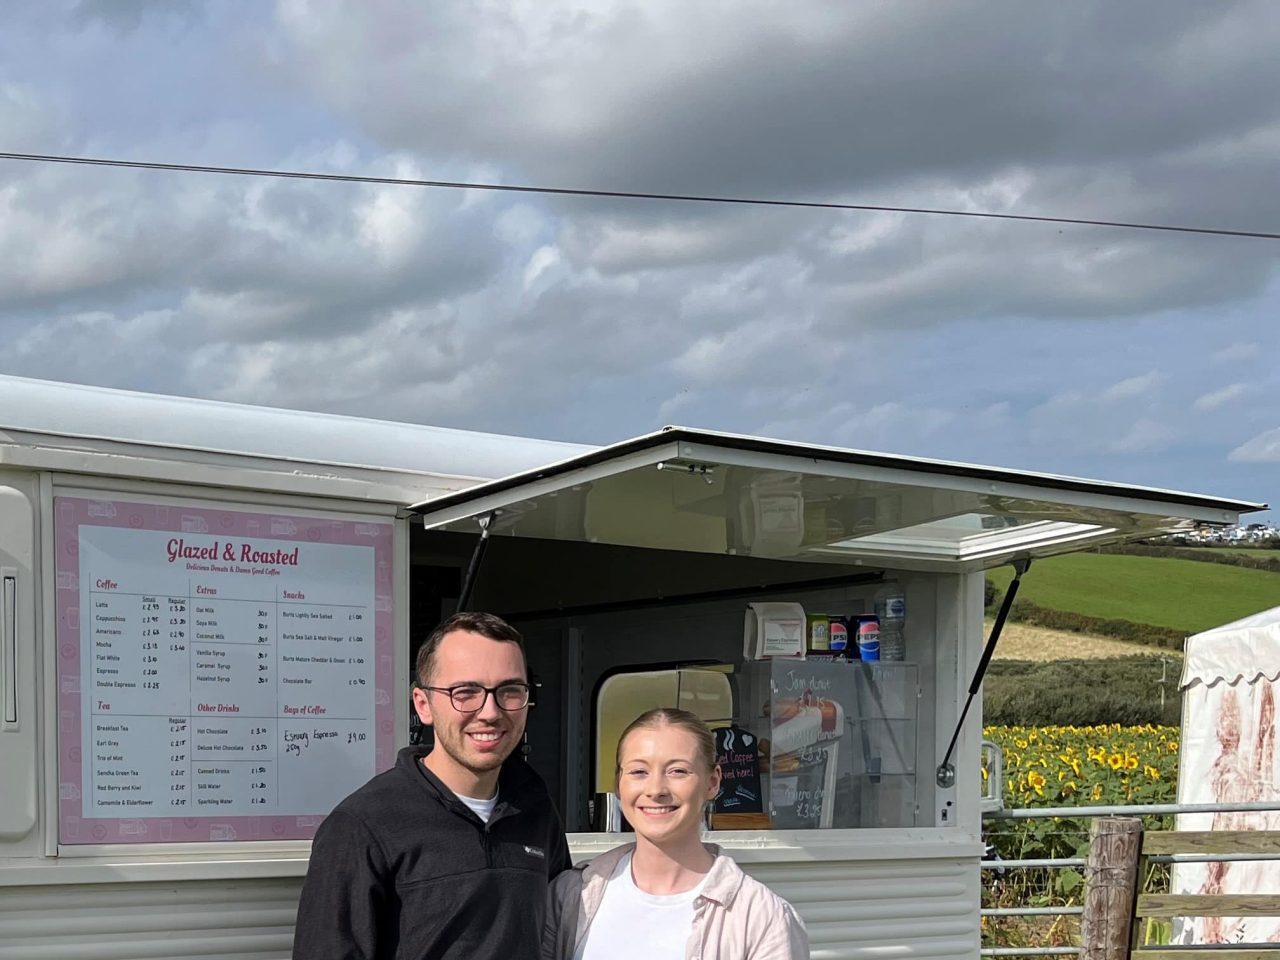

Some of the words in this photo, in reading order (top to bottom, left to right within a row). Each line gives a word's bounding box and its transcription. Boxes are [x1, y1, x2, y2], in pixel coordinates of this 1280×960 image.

[167, 538, 218, 562] Glazed
[223, 543, 236, 561] &
[240, 544, 298, 565] Roasted
[186, 563, 209, 571] Delicious
[211, 564, 228, 572] Donuts
[236, 566, 250, 574] Damn
[265, 568, 280, 576] Coffee
[96, 580, 118, 589] Coffee
[196, 585, 216, 594] Extras
[283, 590, 304, 600] Snacks
[858, 633, 880, 641] PEPS
[785, 670, 805, 691] Jam
[98, 701, 110, 710] Tea
[198, 703, 216, 712] Other
[218, 704, 240, 712] Drinks
[284, 705, 298, 715] Bags
[300, 706, 306, 714] of
[307, 706, 326, 714] Coffee
[314, 729, 338, 740] Espresso
[286, 744, 300, 756] 250g
